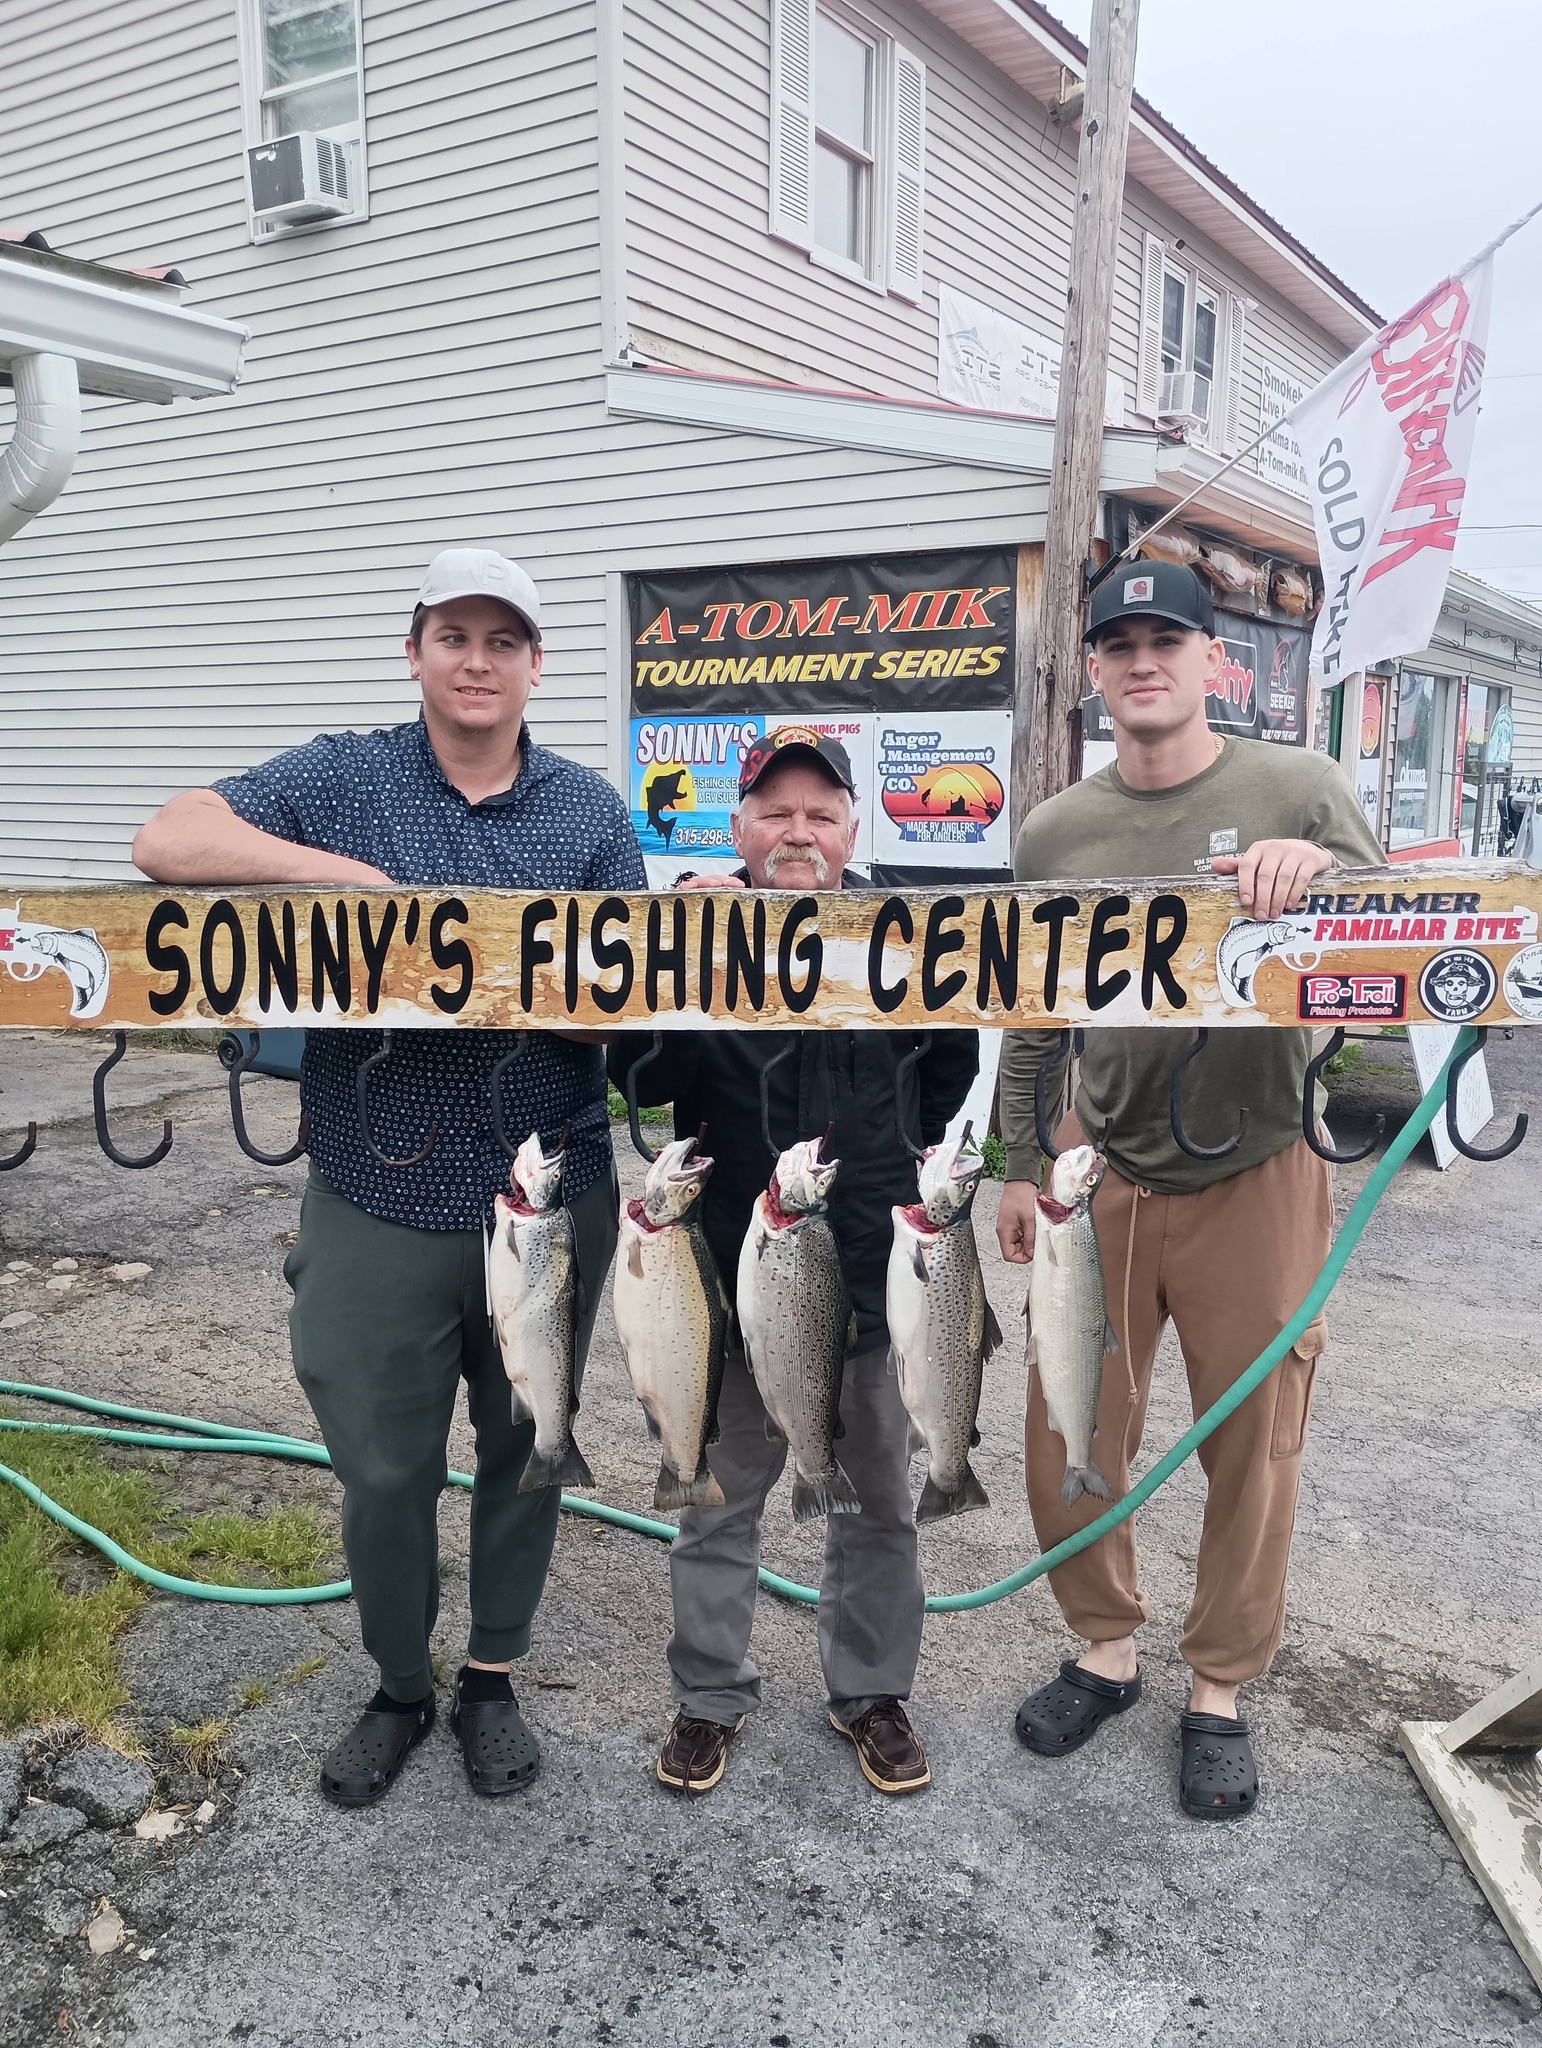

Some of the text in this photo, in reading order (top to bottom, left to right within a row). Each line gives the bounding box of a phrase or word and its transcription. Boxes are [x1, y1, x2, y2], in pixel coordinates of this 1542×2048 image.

[1262, 392, 1280, 418] Live
[1318, 437, 1366, 552] SOLD
[636, 585, 1011, 645] A-TOM-MIK
[636, 646, 1007, 688] TOURNAMENT SERIES
[1270, 693, 1295, 710] SEEKER
[838, 723, 861, 735] PIGS
[637, 721, 759, 766] SONNY'S
[882, 731, 940, 750] Anger
[886, 748, 994, 765] Management
[879, 763, 927, 774] Tackle
[692, 777, 724, 789] FISHING
[885, 776, 917, 791] CO.
[697, 792, 704, 803] &
[705, 792, 717, 803] RV
[906, 821, 929, 832] MADE
[929, 821, 941, 832] BY
[916, 831, 968, 842] FOR ANGLERS
[1313, 916, 1525, 942] FAMILIAR BITE
[146, 894, 1189, 1016] SONNY'S FISHING CENTER
[1306, 976, 1397, 1005] Pro-Troll
[1309, 1005, 1393, 1017] Fishing Products
